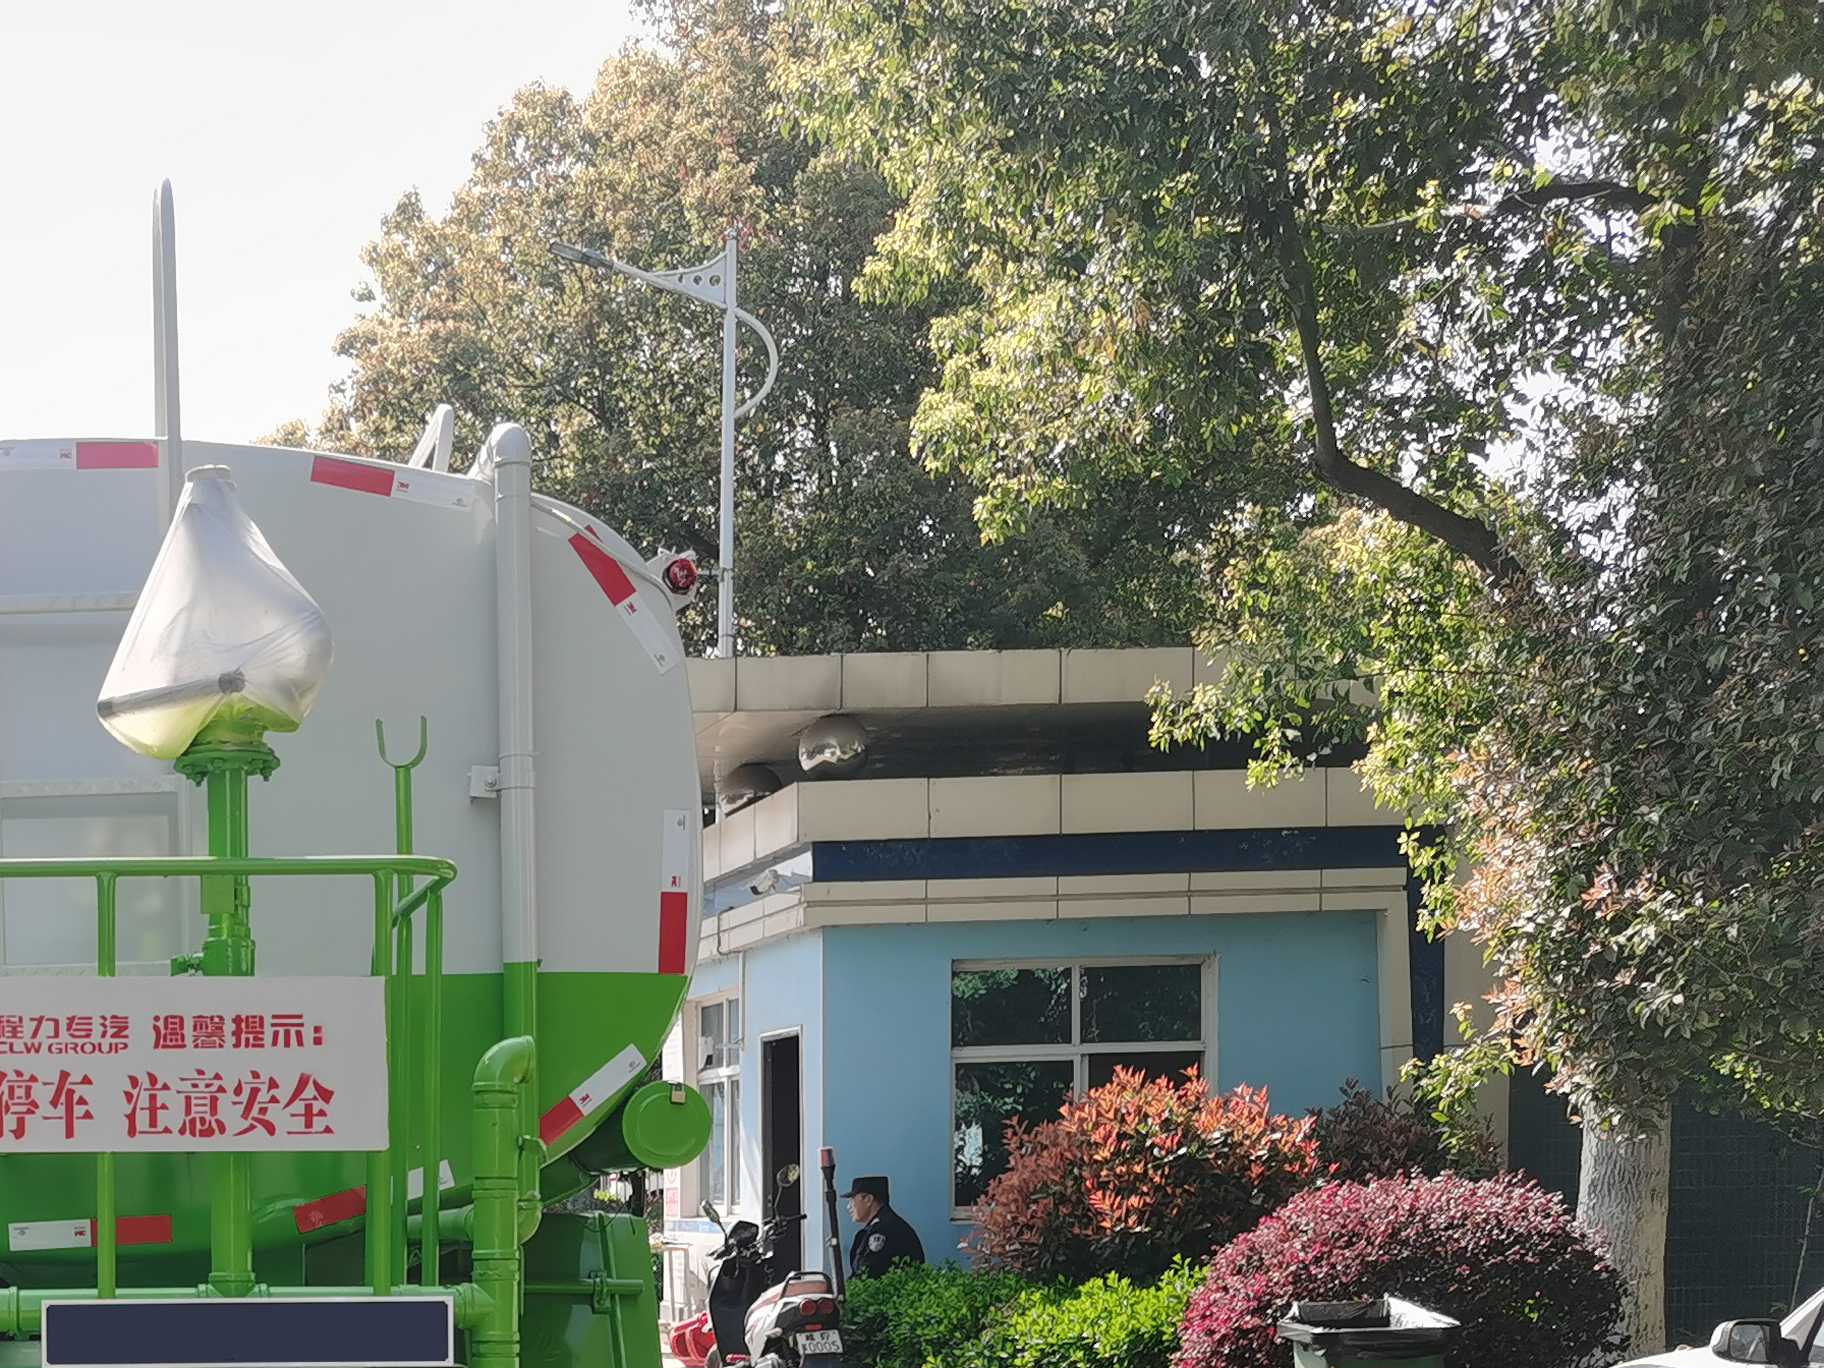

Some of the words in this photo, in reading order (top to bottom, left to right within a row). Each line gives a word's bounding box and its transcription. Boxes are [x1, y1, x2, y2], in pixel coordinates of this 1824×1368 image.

[47, 1041, 130, 1055] GROUP
[122, 1068, 336, 1139] 注意安全
